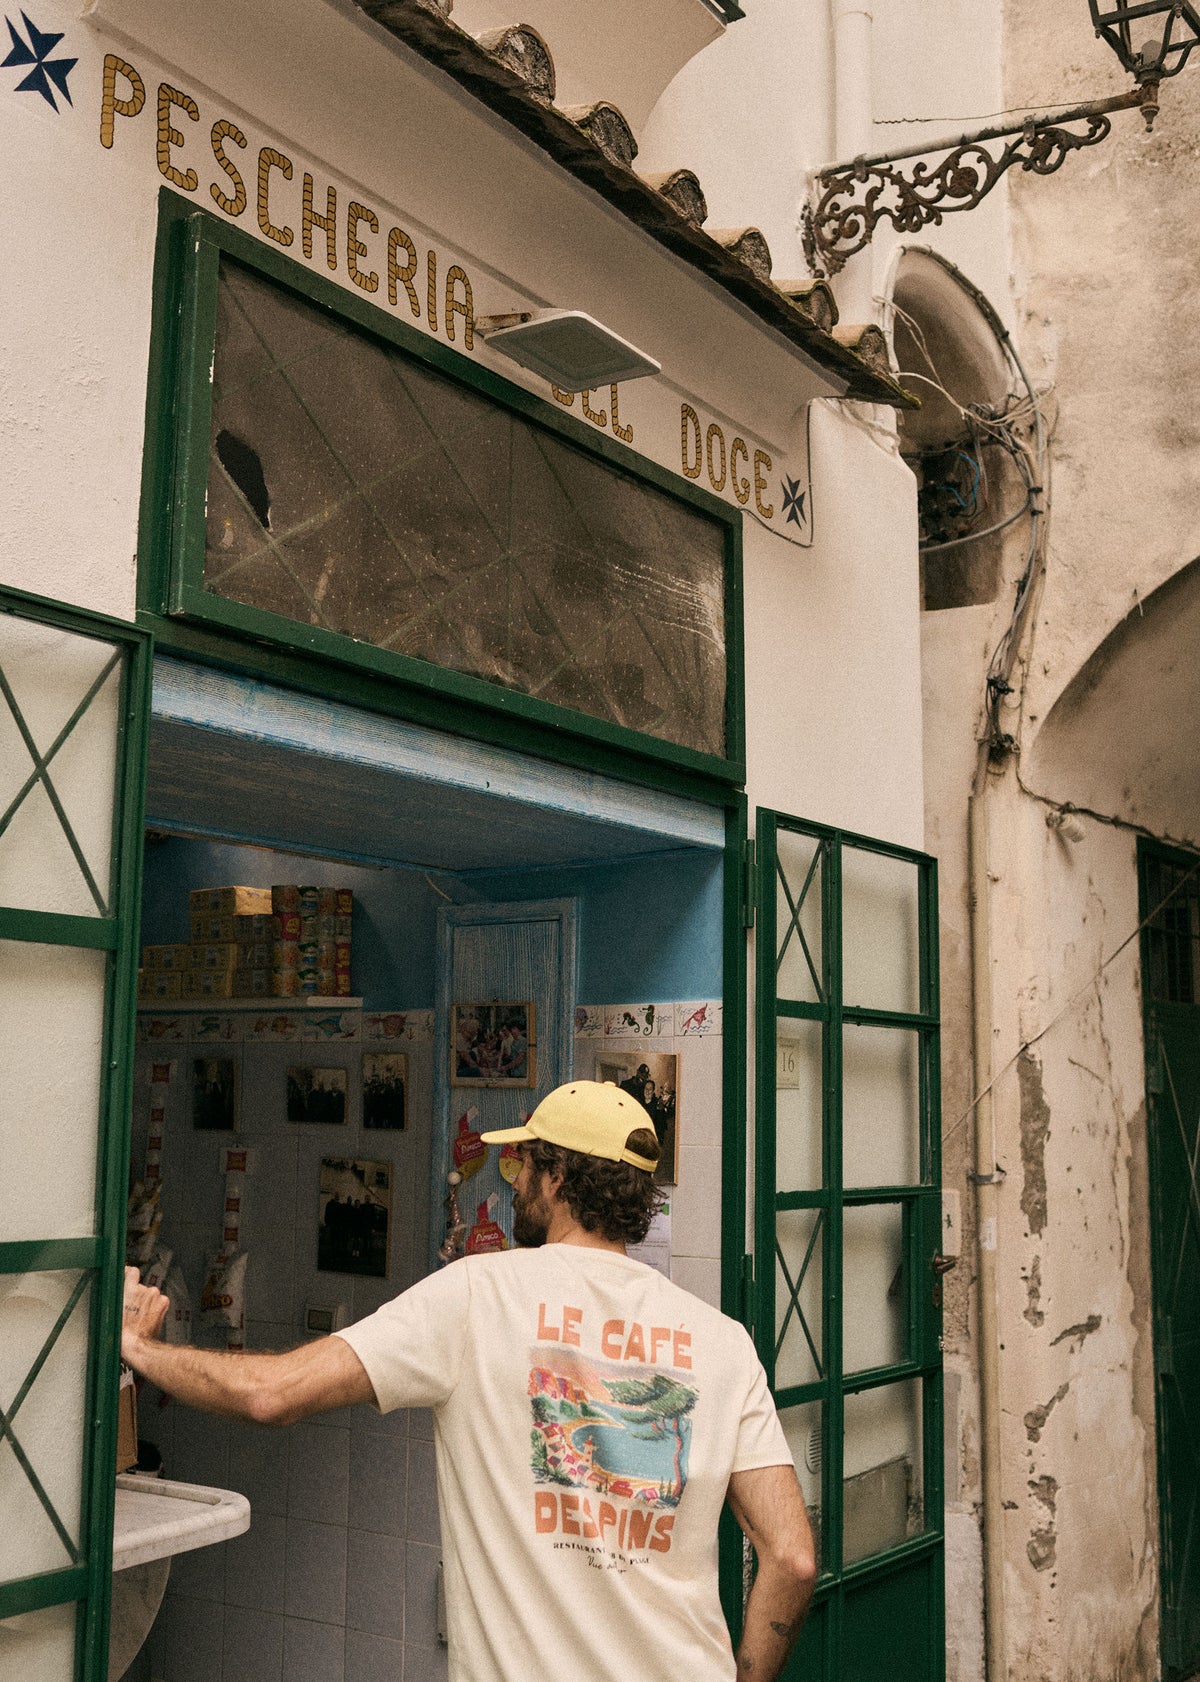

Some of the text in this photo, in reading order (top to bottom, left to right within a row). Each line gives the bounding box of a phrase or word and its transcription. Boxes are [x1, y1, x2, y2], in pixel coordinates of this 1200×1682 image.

[100, 54, 473, 351] PESCHERIA
[681, 403, 773, 519] DOGE
[782, 1051, 795, 1073] 16
[537, 1303, 693, 1370] LE CAFÉ
